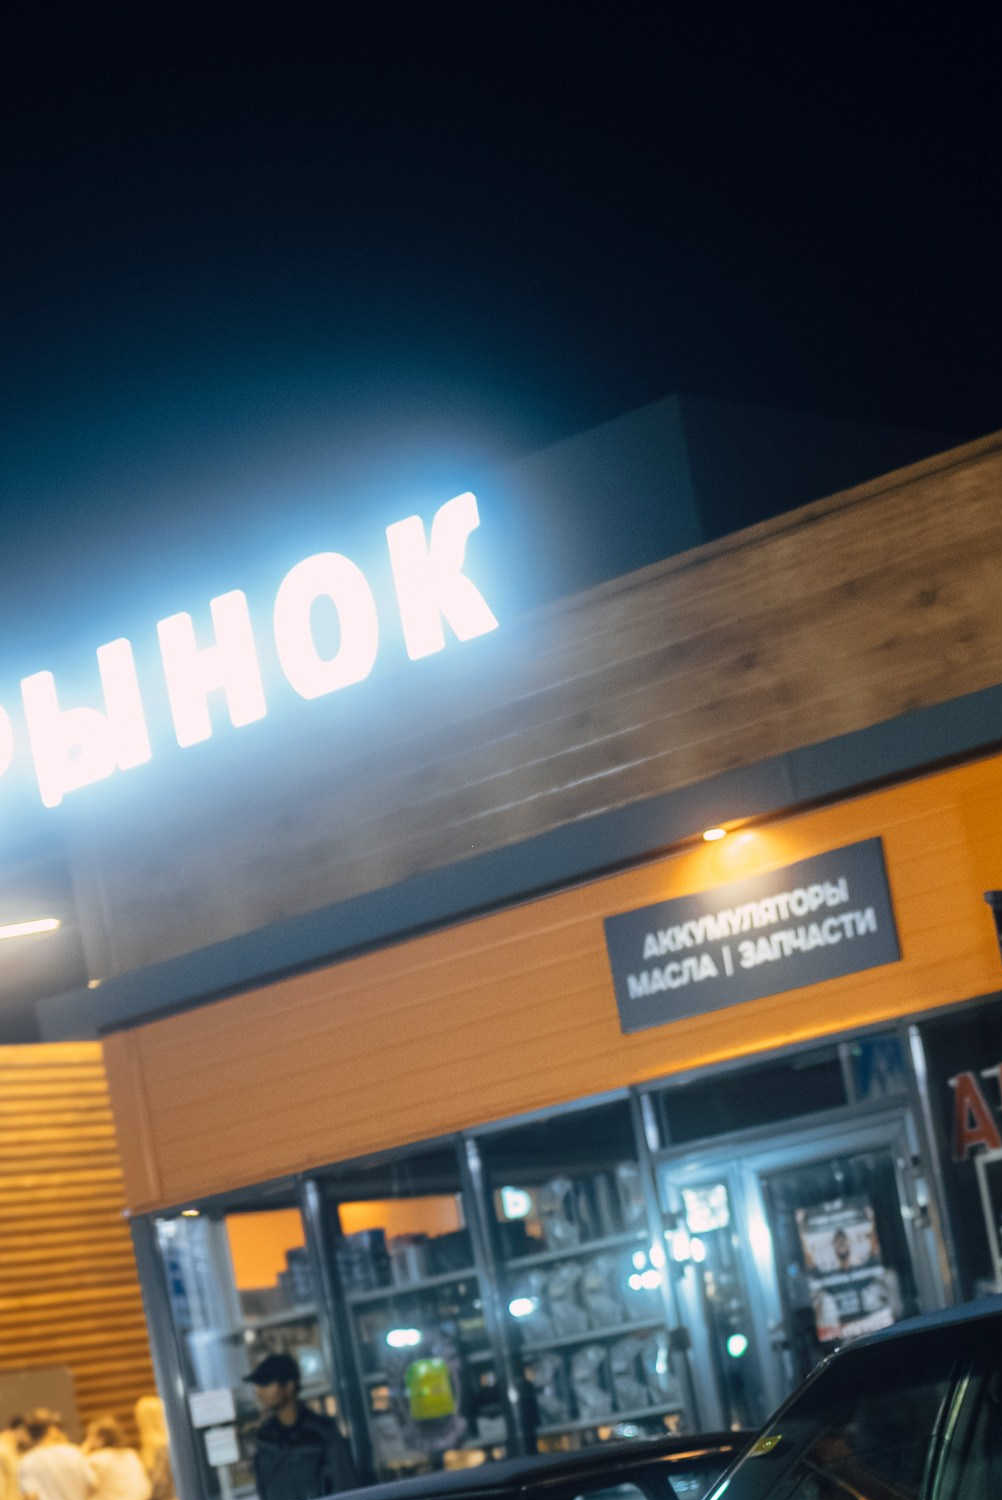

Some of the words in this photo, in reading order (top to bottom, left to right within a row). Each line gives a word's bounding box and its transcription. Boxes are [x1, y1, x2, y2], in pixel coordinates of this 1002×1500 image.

[0, 491, 499, 809] ЫНОК
[626, 953, 718, 999] МАСЛА
[738, 907, 878, 969] ЗАПЧАСТИ
[643, 877, 850, 960] АККУМУЛЯТОРЫ
